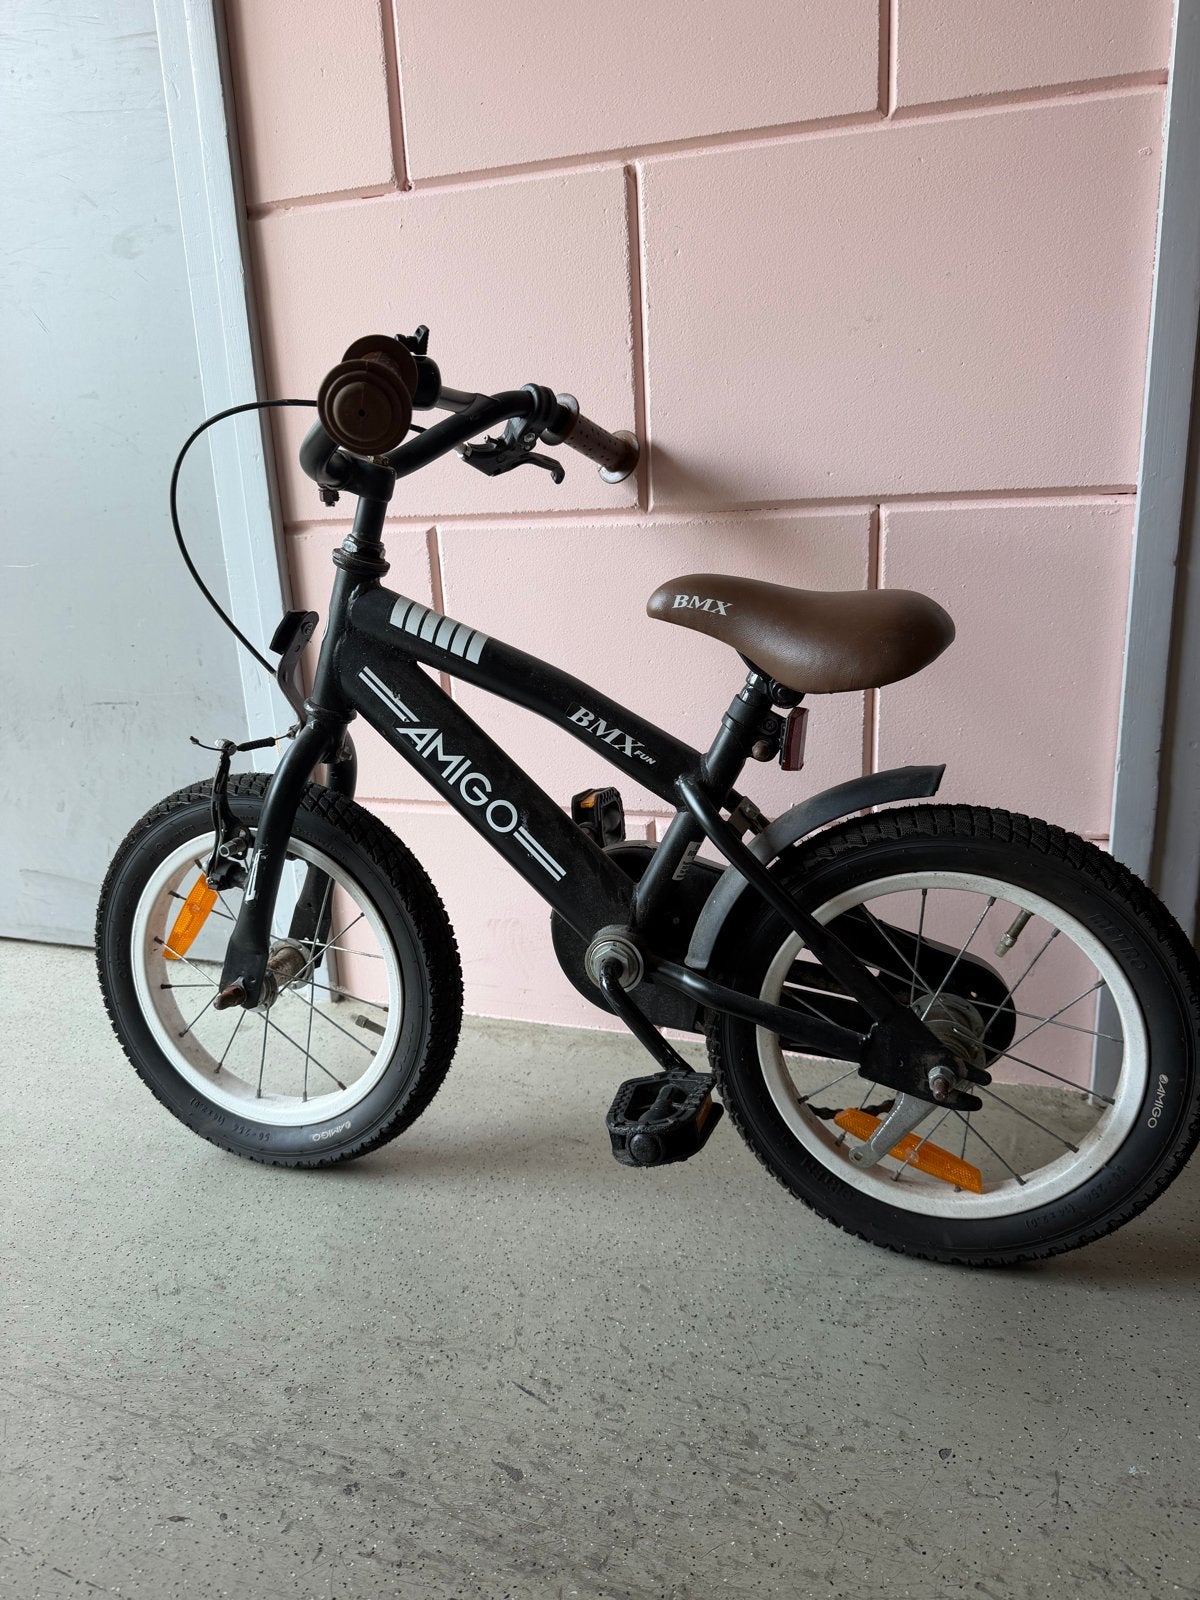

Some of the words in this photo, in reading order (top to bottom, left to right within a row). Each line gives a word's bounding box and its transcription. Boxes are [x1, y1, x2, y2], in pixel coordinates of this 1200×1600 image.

[672, 594, 734, 616] BMX
[566, 705, 644, 759] BMX
[633, 749, 658, 766] FUN
[395, 727, 519, 833] AMIGO
[1147, 1084, 1166, 1129] AMIGO
[311, 1124, 346, 1142] AMIGO
